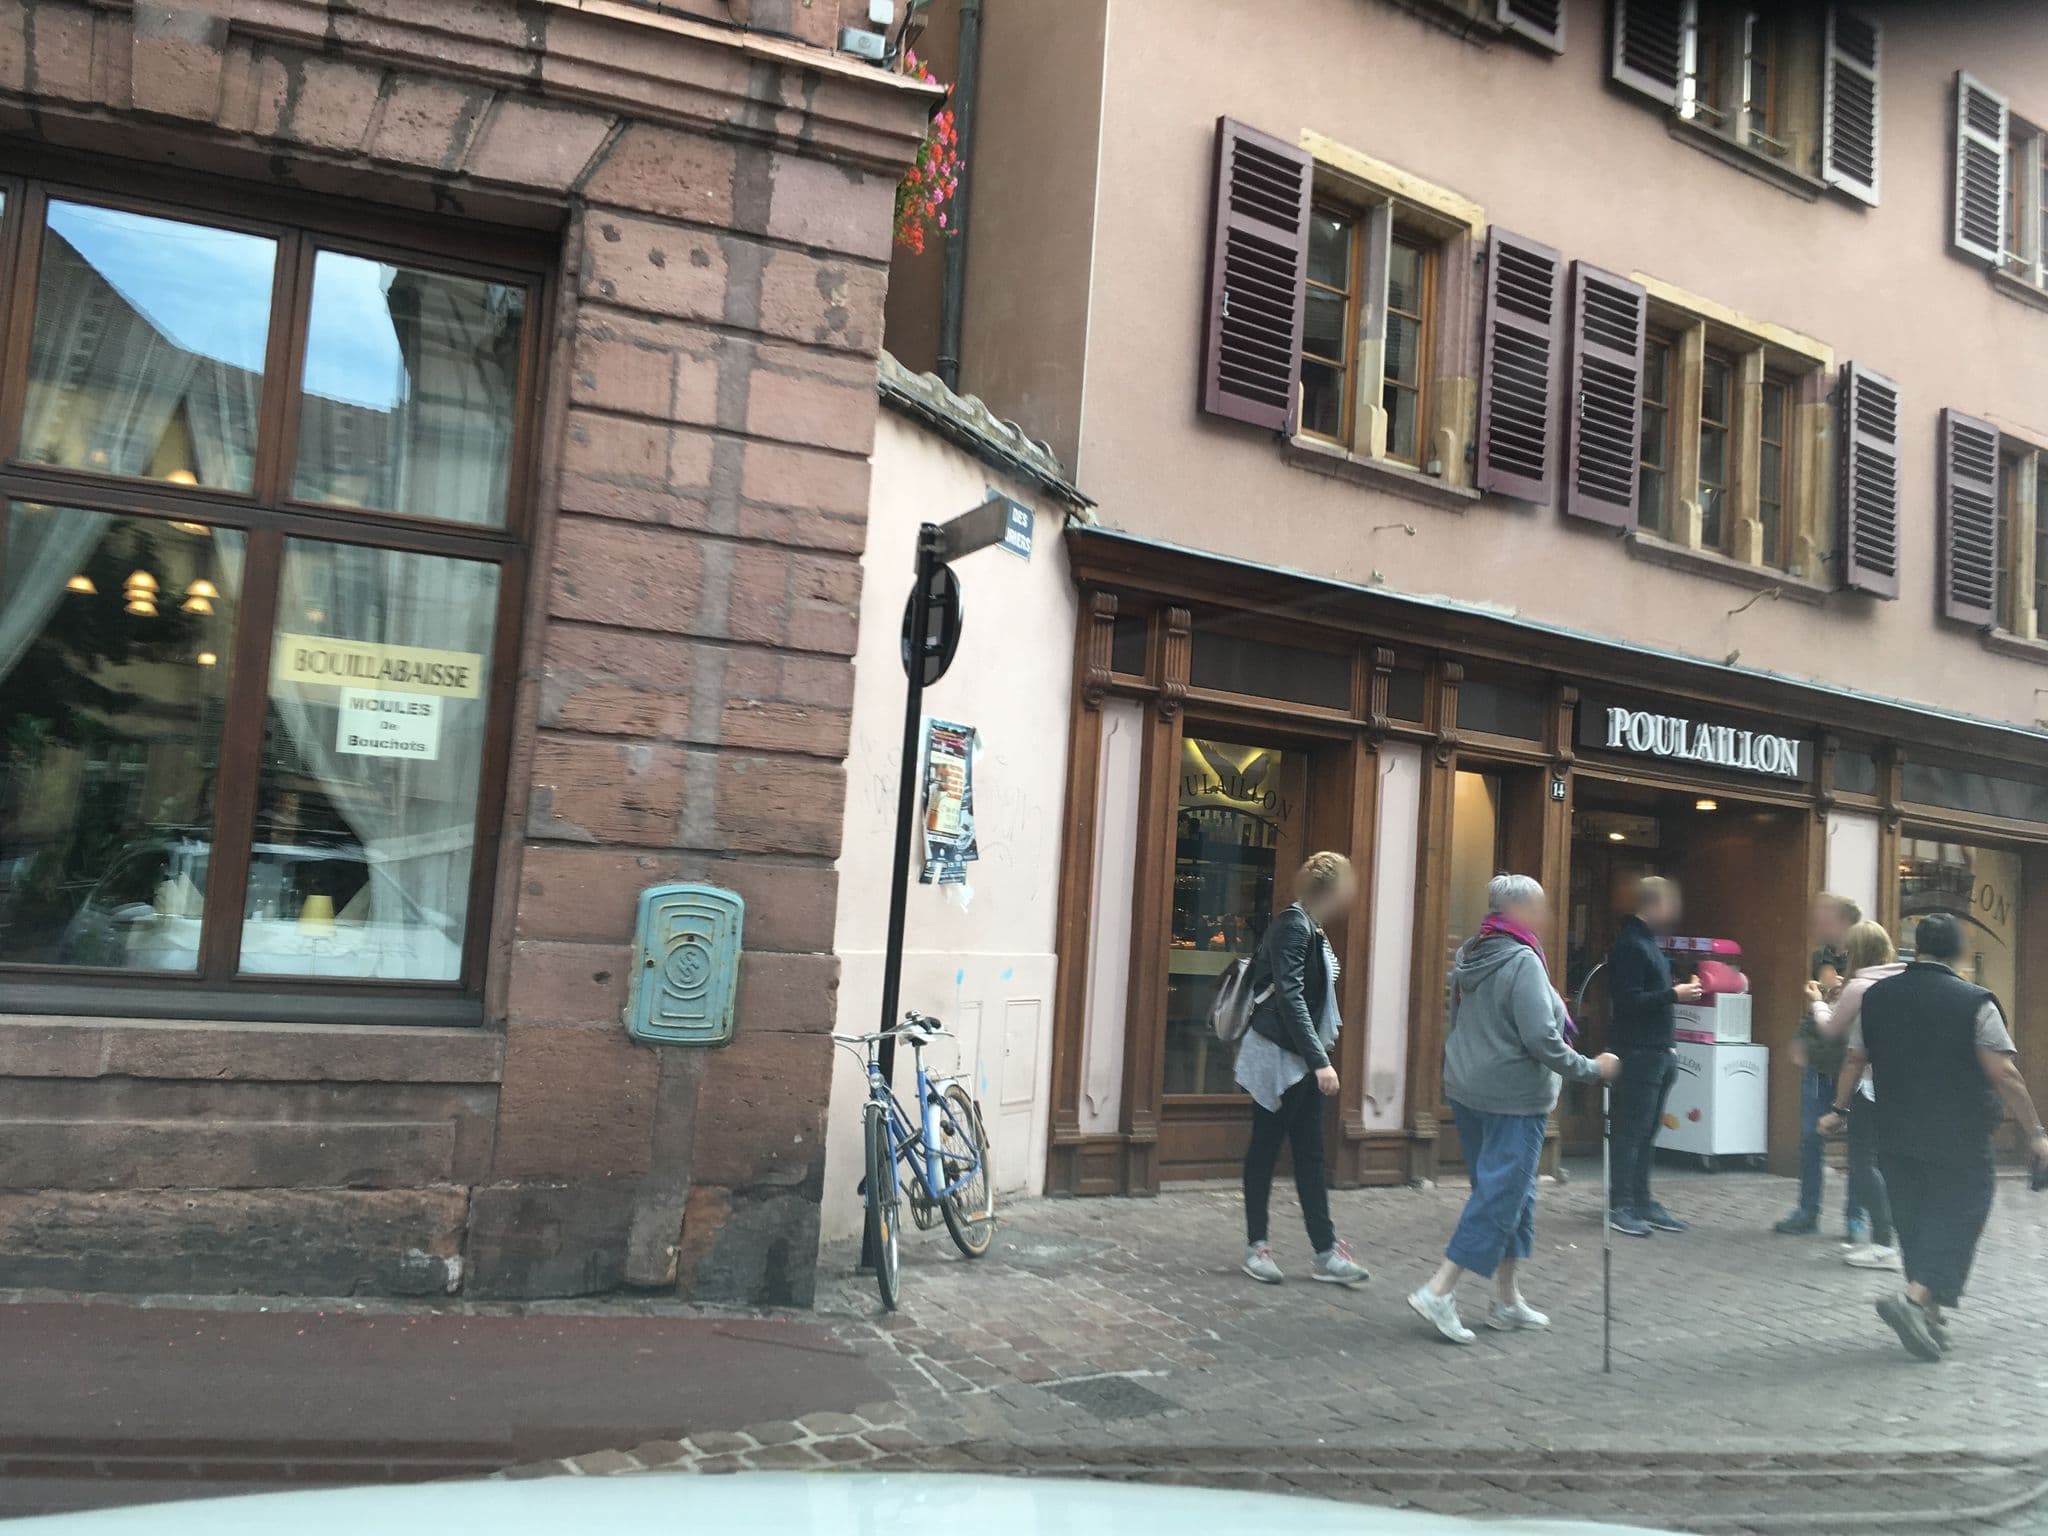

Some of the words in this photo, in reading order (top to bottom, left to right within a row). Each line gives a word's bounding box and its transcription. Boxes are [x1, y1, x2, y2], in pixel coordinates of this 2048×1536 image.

[293, 648, 470, 688] BOUILLABAISSE
[351, 697, 432, 716] MOULES
[380, 720, 399, 731] De
[347, 735, 426, 752] Bouchots
[1606, 707, 1800, 777] POULAILLON
[1178, 773, 1293, 822] ULAILLON
[1553, 783, 1565, 797] 14
